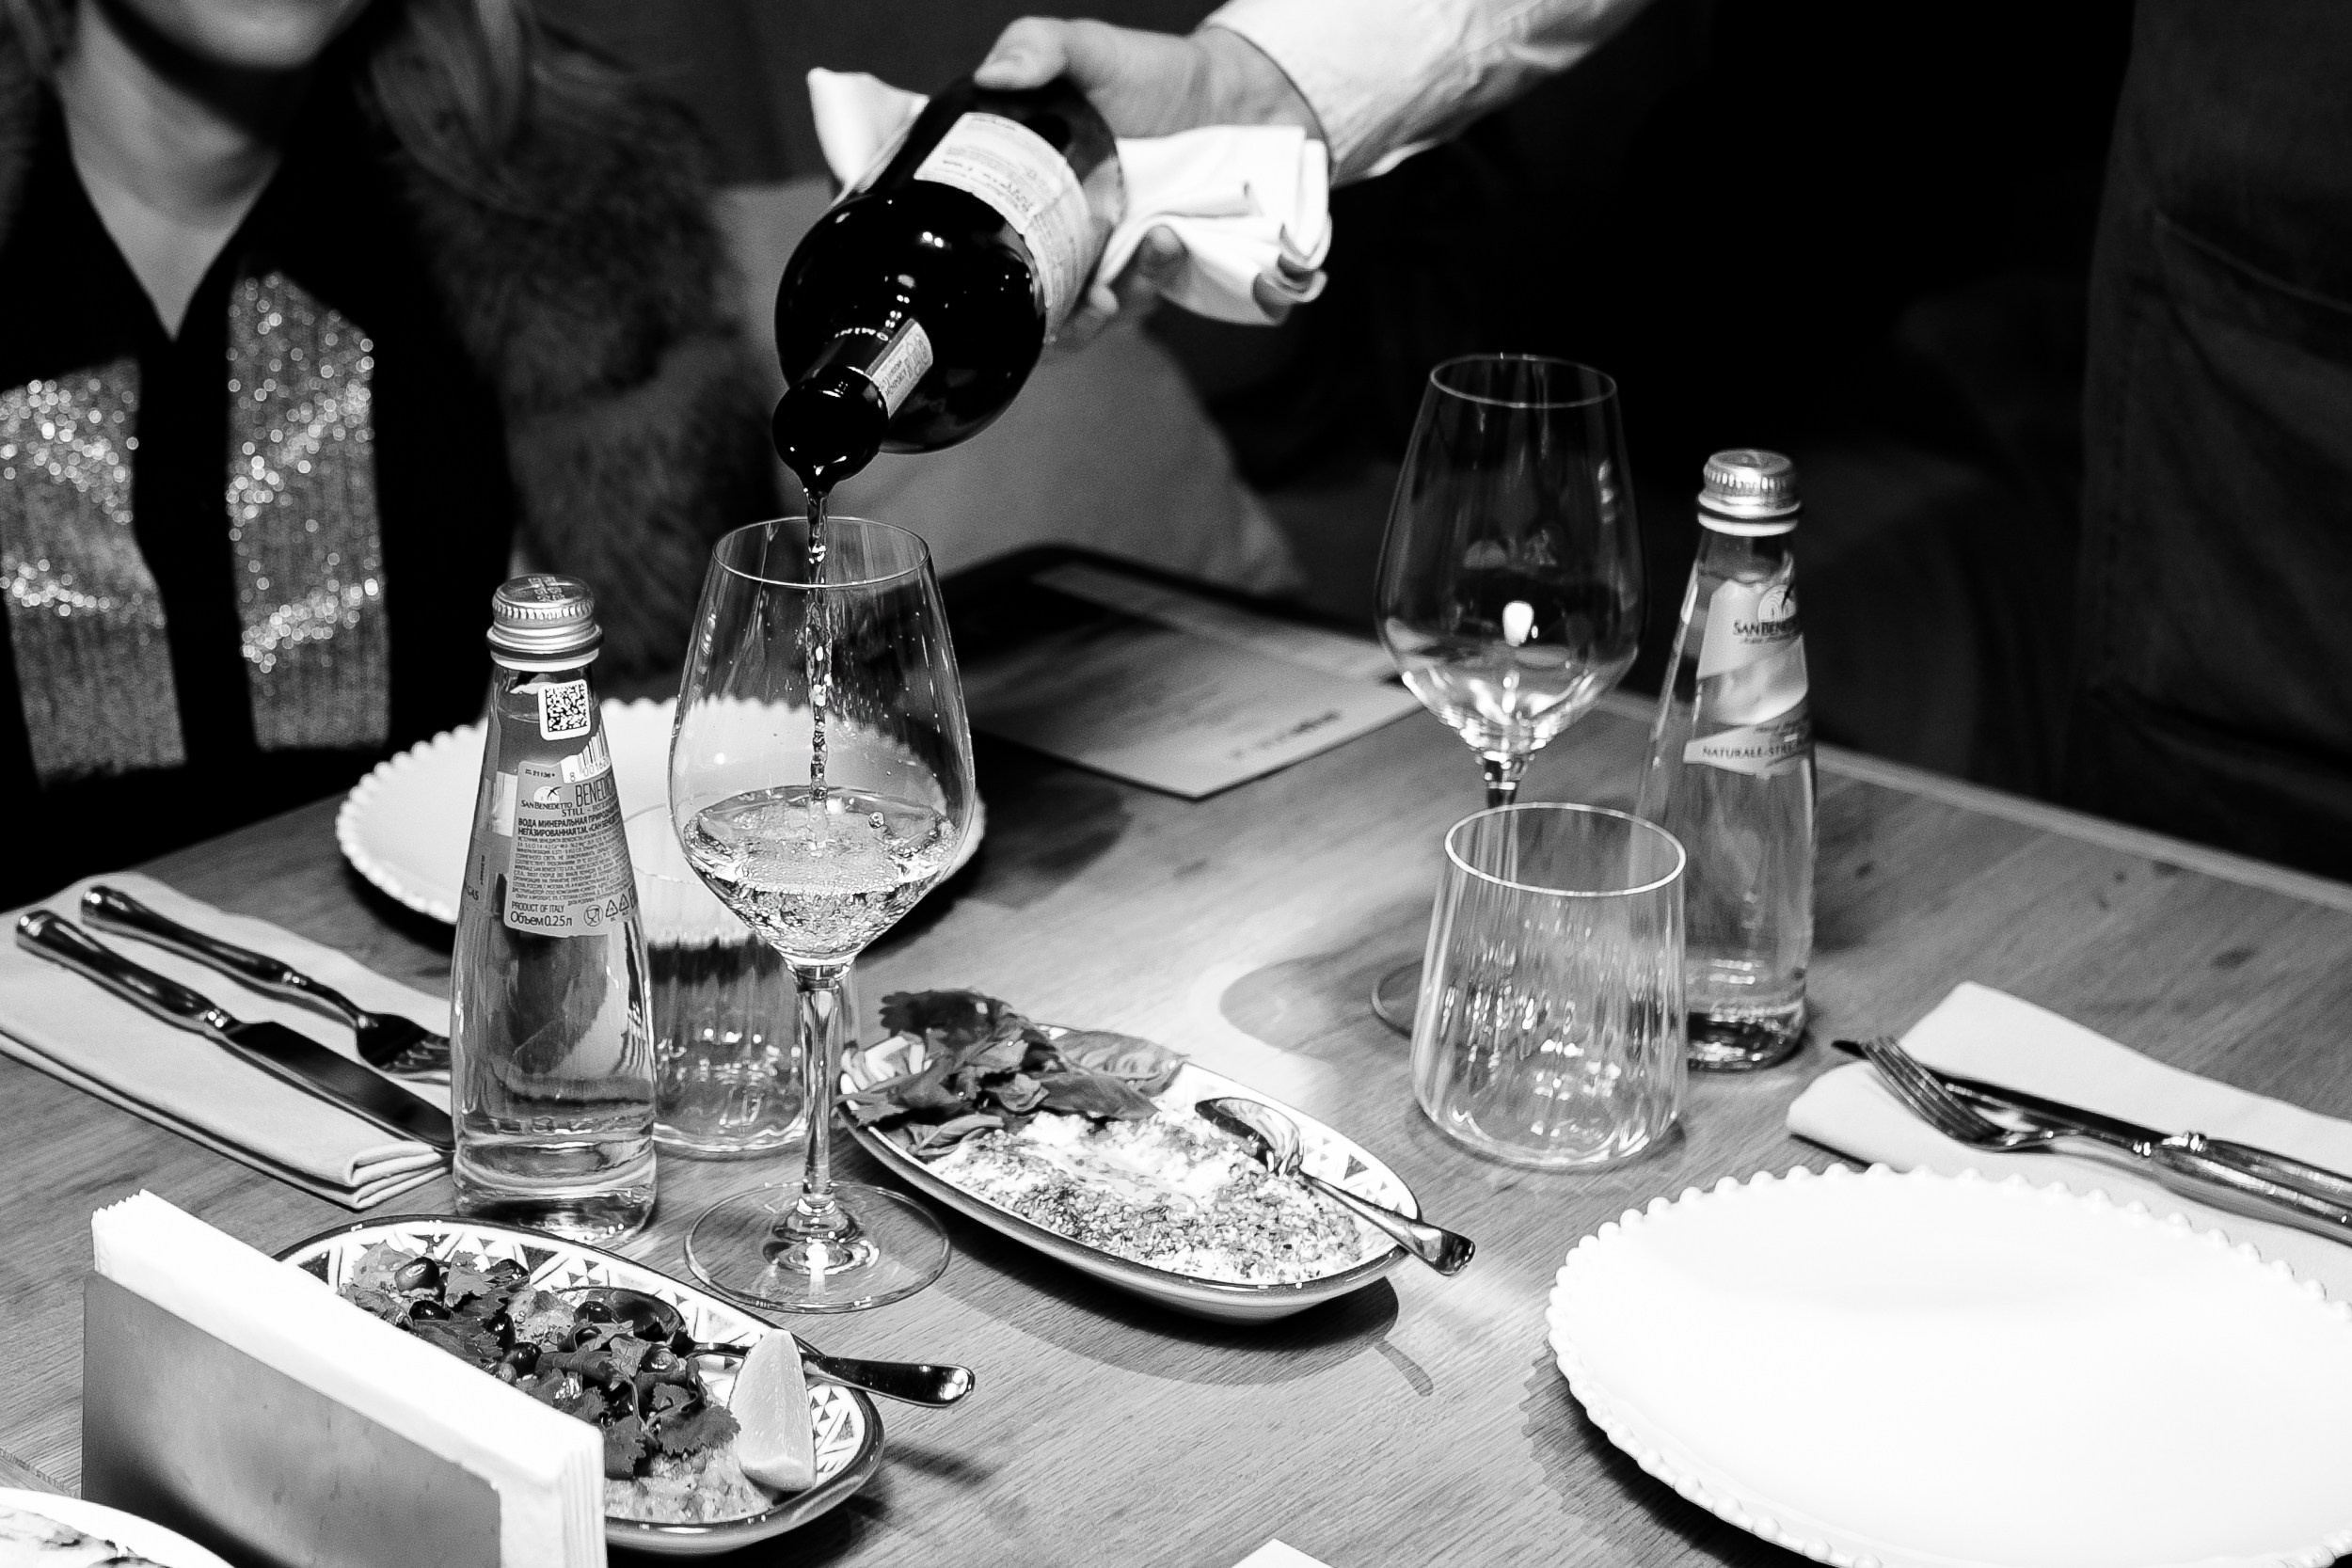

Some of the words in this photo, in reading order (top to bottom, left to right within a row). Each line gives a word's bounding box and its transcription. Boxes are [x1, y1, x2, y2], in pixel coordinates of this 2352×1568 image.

[562, 807, 584, 818] STILL
[518, 817, 537, 828] ВОДА
[538, 816, 588, 828] МИНЕРАЛЬНАЯ
[518, 827, 577, 837] НЕГАЗИРОВАННАЯ
[511, 900, 538, 912] PRODUCT
[540, 904, 548, 912] OF
[549, 904, 564, 913] ITALY
[511, 911, 544, 927] Объем
